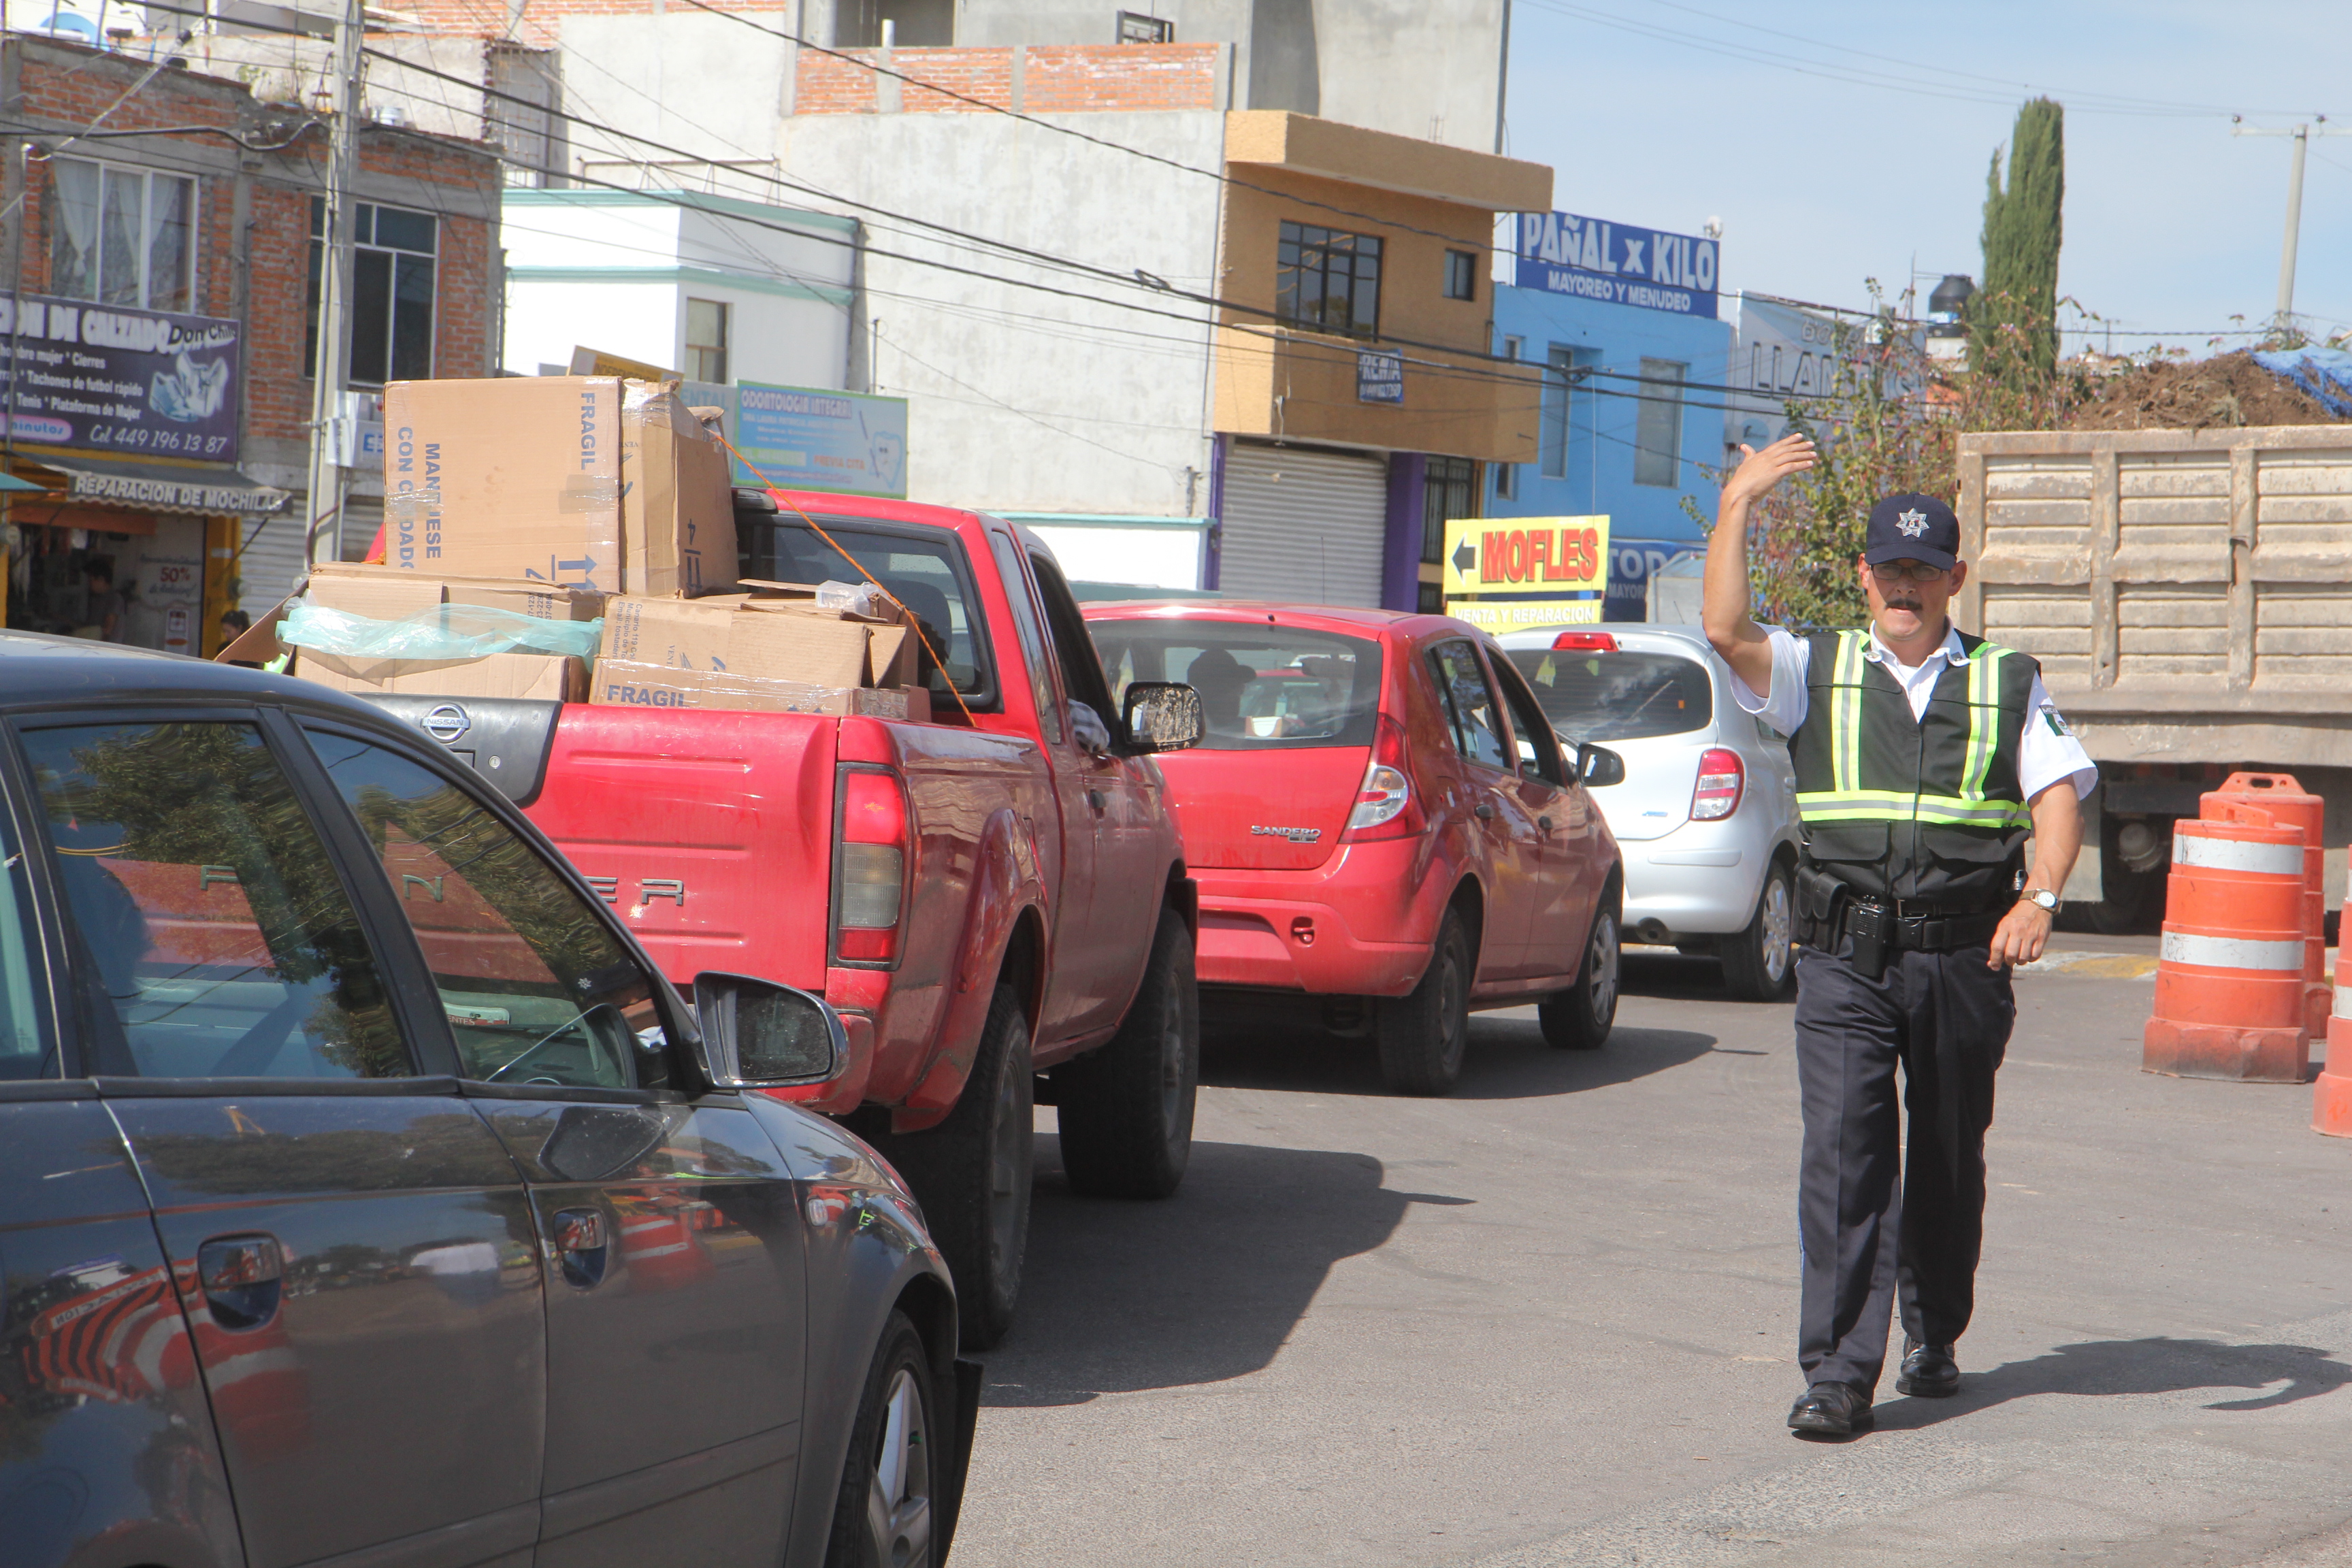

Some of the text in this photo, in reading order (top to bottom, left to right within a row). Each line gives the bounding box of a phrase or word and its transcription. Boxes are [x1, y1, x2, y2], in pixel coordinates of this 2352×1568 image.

[1524, 212, 1618, 276] PAÑAL
[1652, 233, 1715, 291] KILO
[1548, 270, 1691, 312] MAYOREO Y MENUDEO
[48, 304, 79, 343] DE
[82, 309, 171, 355] CALZADO
[167, 325, 204, 345] Don
[36, 348, 64, 367] mujer
[71, 351, 106, 370] Cierres
[27, 370, 71, 389] Tachones
[73, 376, 85, 391] de
[86, 376, 114, 393] futbol
[16, 391, 42, 408] Tenis
[50, 395, 101, 416] Plataforma
[101, 403, 114, 416] de
[116, 404, 142, 422] Mujer
[90, 424, 227, 454] Cel 449 196 13 87
[581, 393, 595, 470] FRAGIL
[75, 477, 175, 503] REPARACION
[180, 489, 202, 506] DE
[397, 426, 415, 569] CON CDAD
[1480, 527, 1599, 583] MOFLES
[623, 602, 634, 637] Municipio
[633, 604, 643, 632] Canario
[1454, 606, 1596, 623] VENTA Y REPARACION
[622, 639, 629, 648] de
[631, 633, 639, 645] 119
[606, 684, 691, 708] FRAGIL
[426, 718, 464, 726] NISSAN
[1250, 825, 1322, 838] SANDERO
